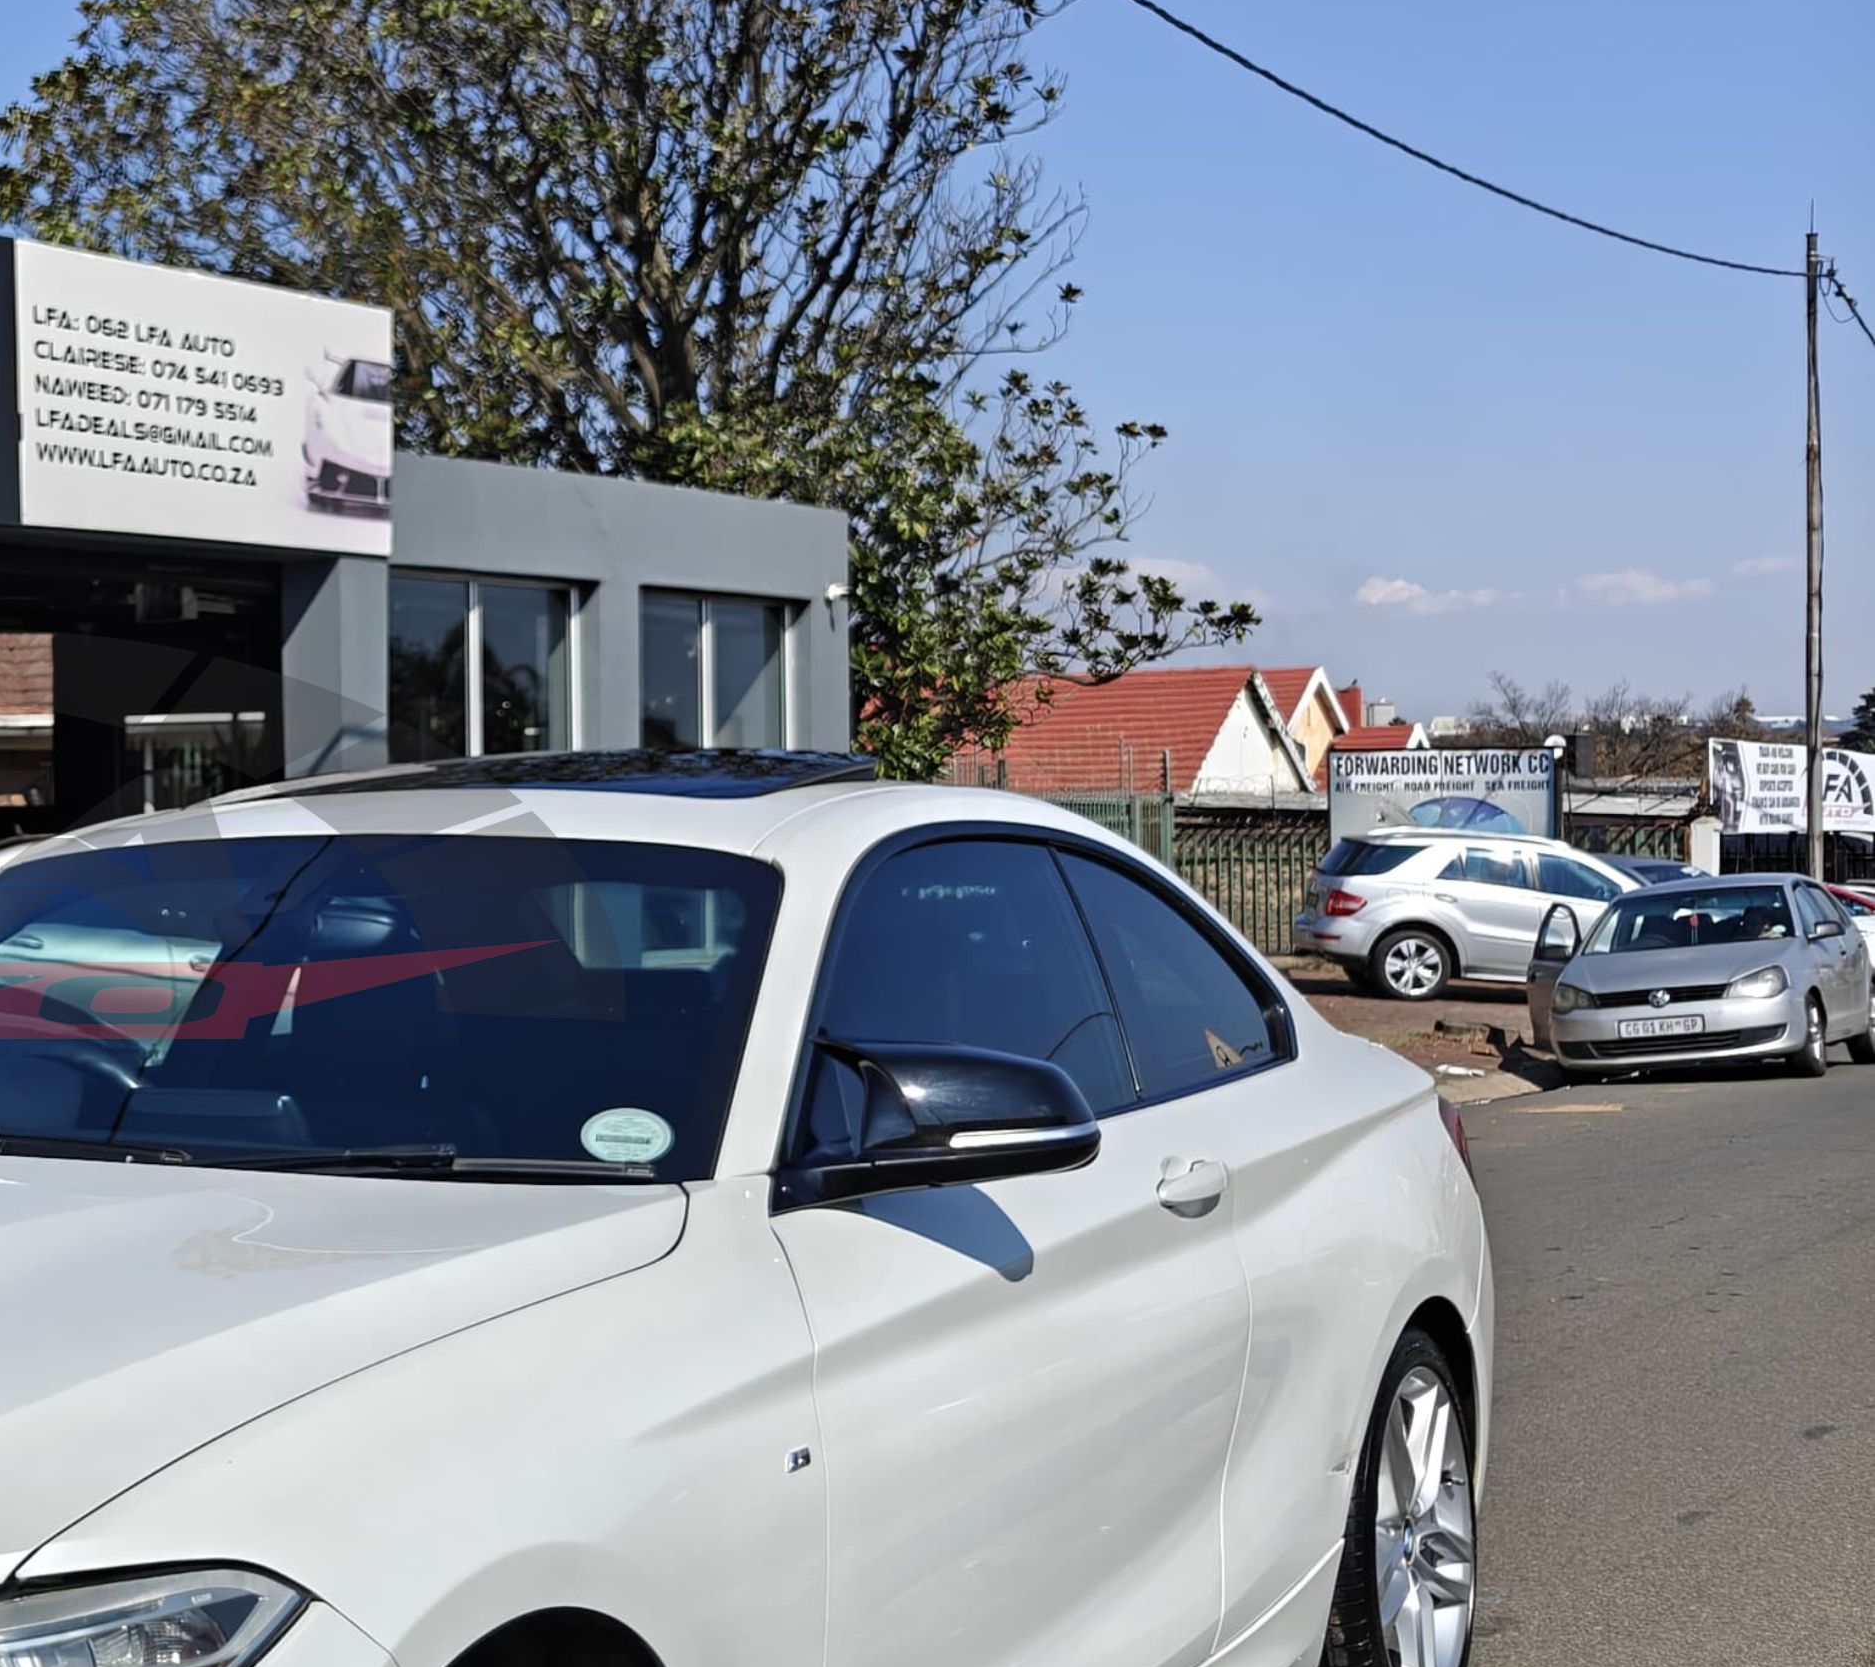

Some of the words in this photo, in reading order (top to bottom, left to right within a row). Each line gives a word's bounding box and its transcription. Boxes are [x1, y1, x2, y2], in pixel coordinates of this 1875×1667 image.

[32, 305, 80, 331] LFA:
[135, 324, 172, 347] LFA
[179, 333, 236, 358] AUTO
[151, 359, 189, 381] 074
[195, 366, 227, 388] 541
[35, 374, 132, 406] NAWEED:
[136, 389, 170, 413] 071
[176, 396, 207, 417] 179
[35, 441, 257, 486] WWW.LFAAUTO.CO.ZA
[1336, 754, 1438, 776] FORWARDING
[1444, 753, 1521, 776] NETWORK
[1528, 753, 1549, 774] CC
